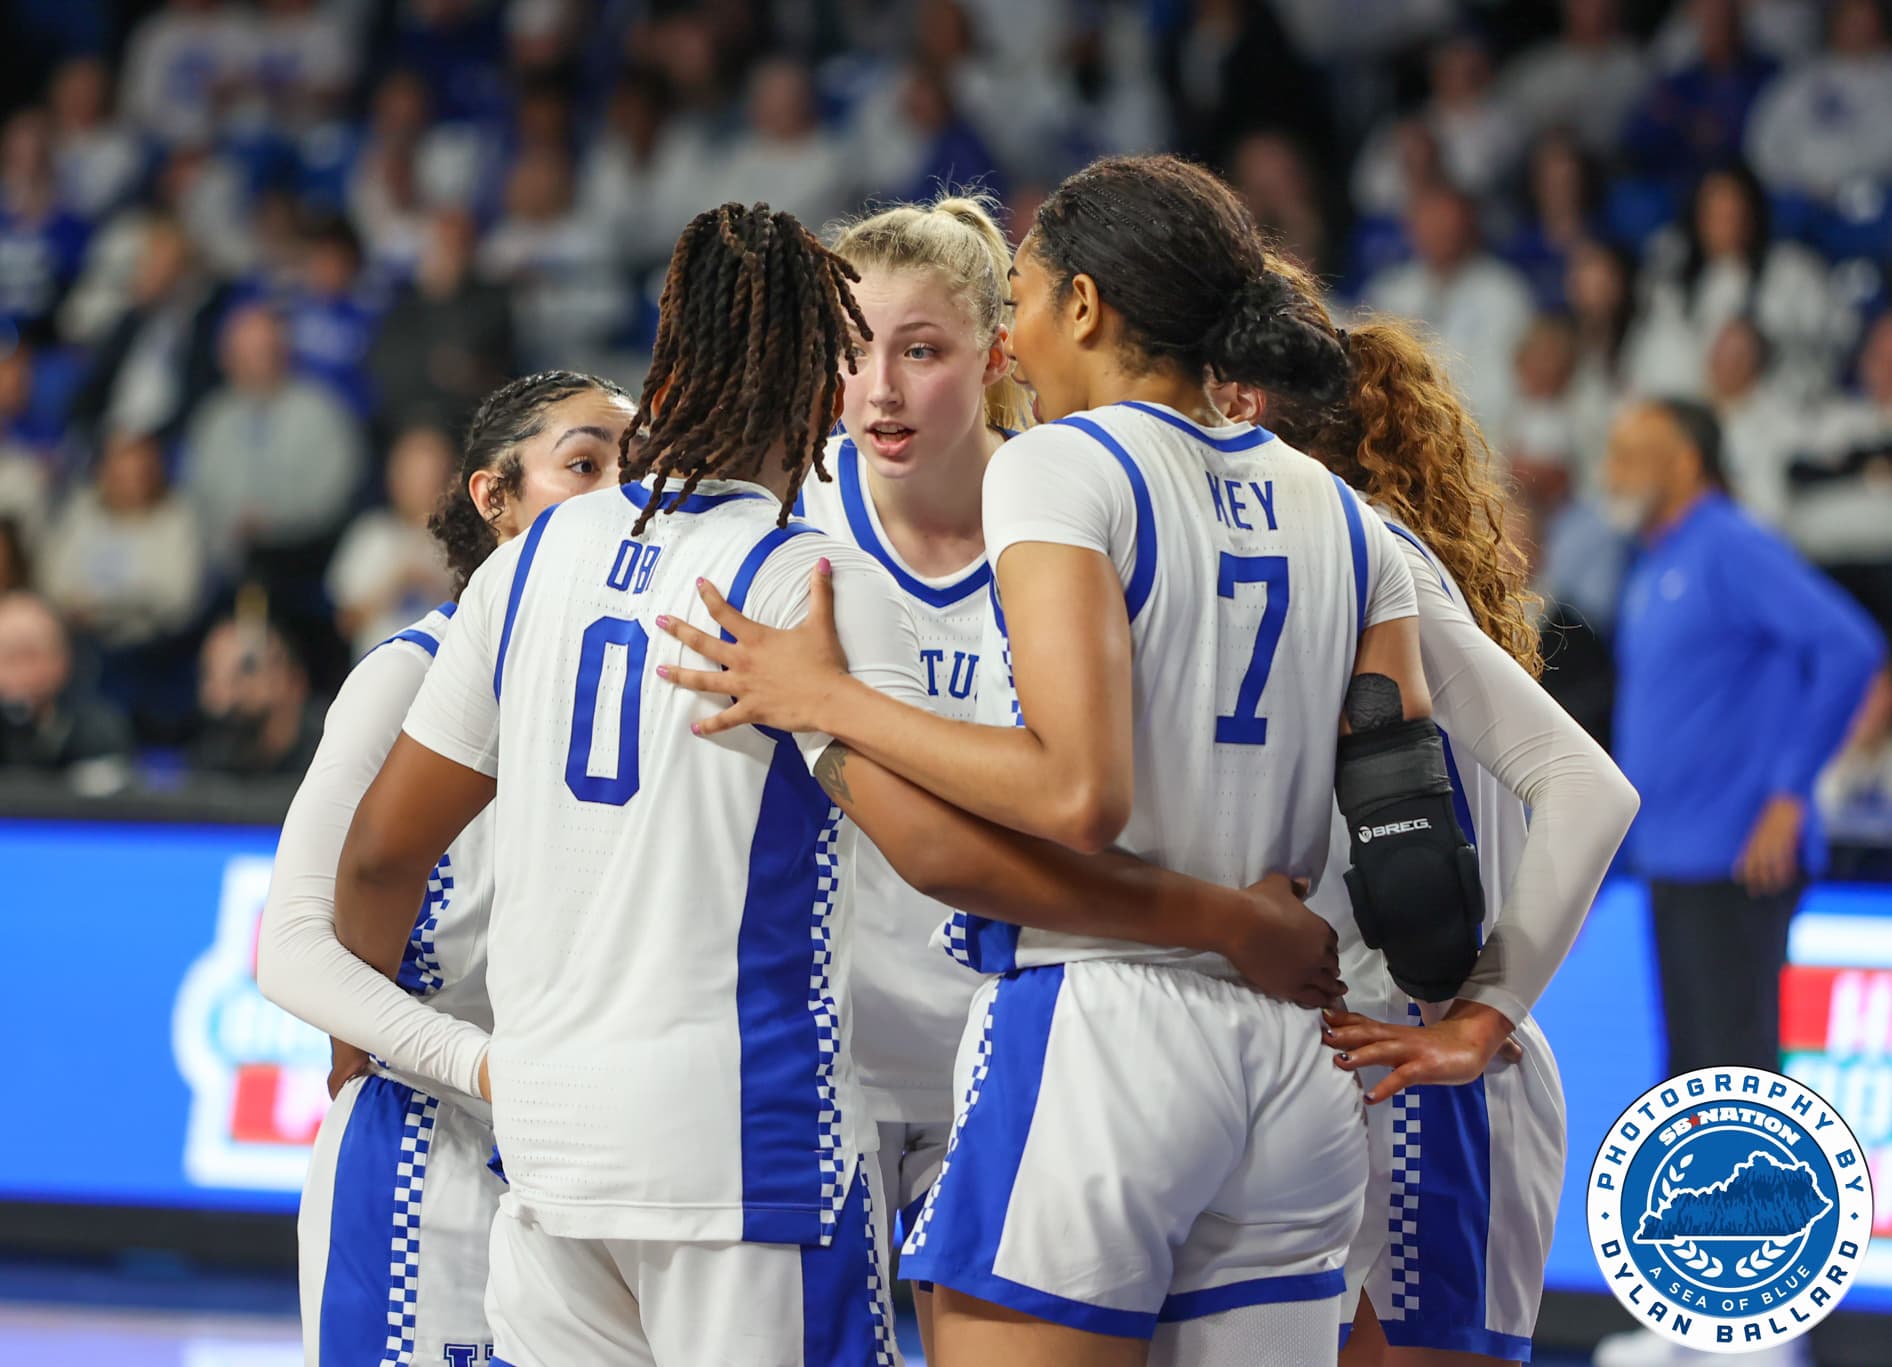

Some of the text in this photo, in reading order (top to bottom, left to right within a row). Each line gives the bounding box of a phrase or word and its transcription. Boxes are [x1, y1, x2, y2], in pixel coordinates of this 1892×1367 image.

[1205, 471, 1278, 530] KEY
[607, 539, 662, 594] OB
[920, 649, 979, 703] TU
[1215, 551, 1289, 745] 7
[565, 616, 649, 806] 0
